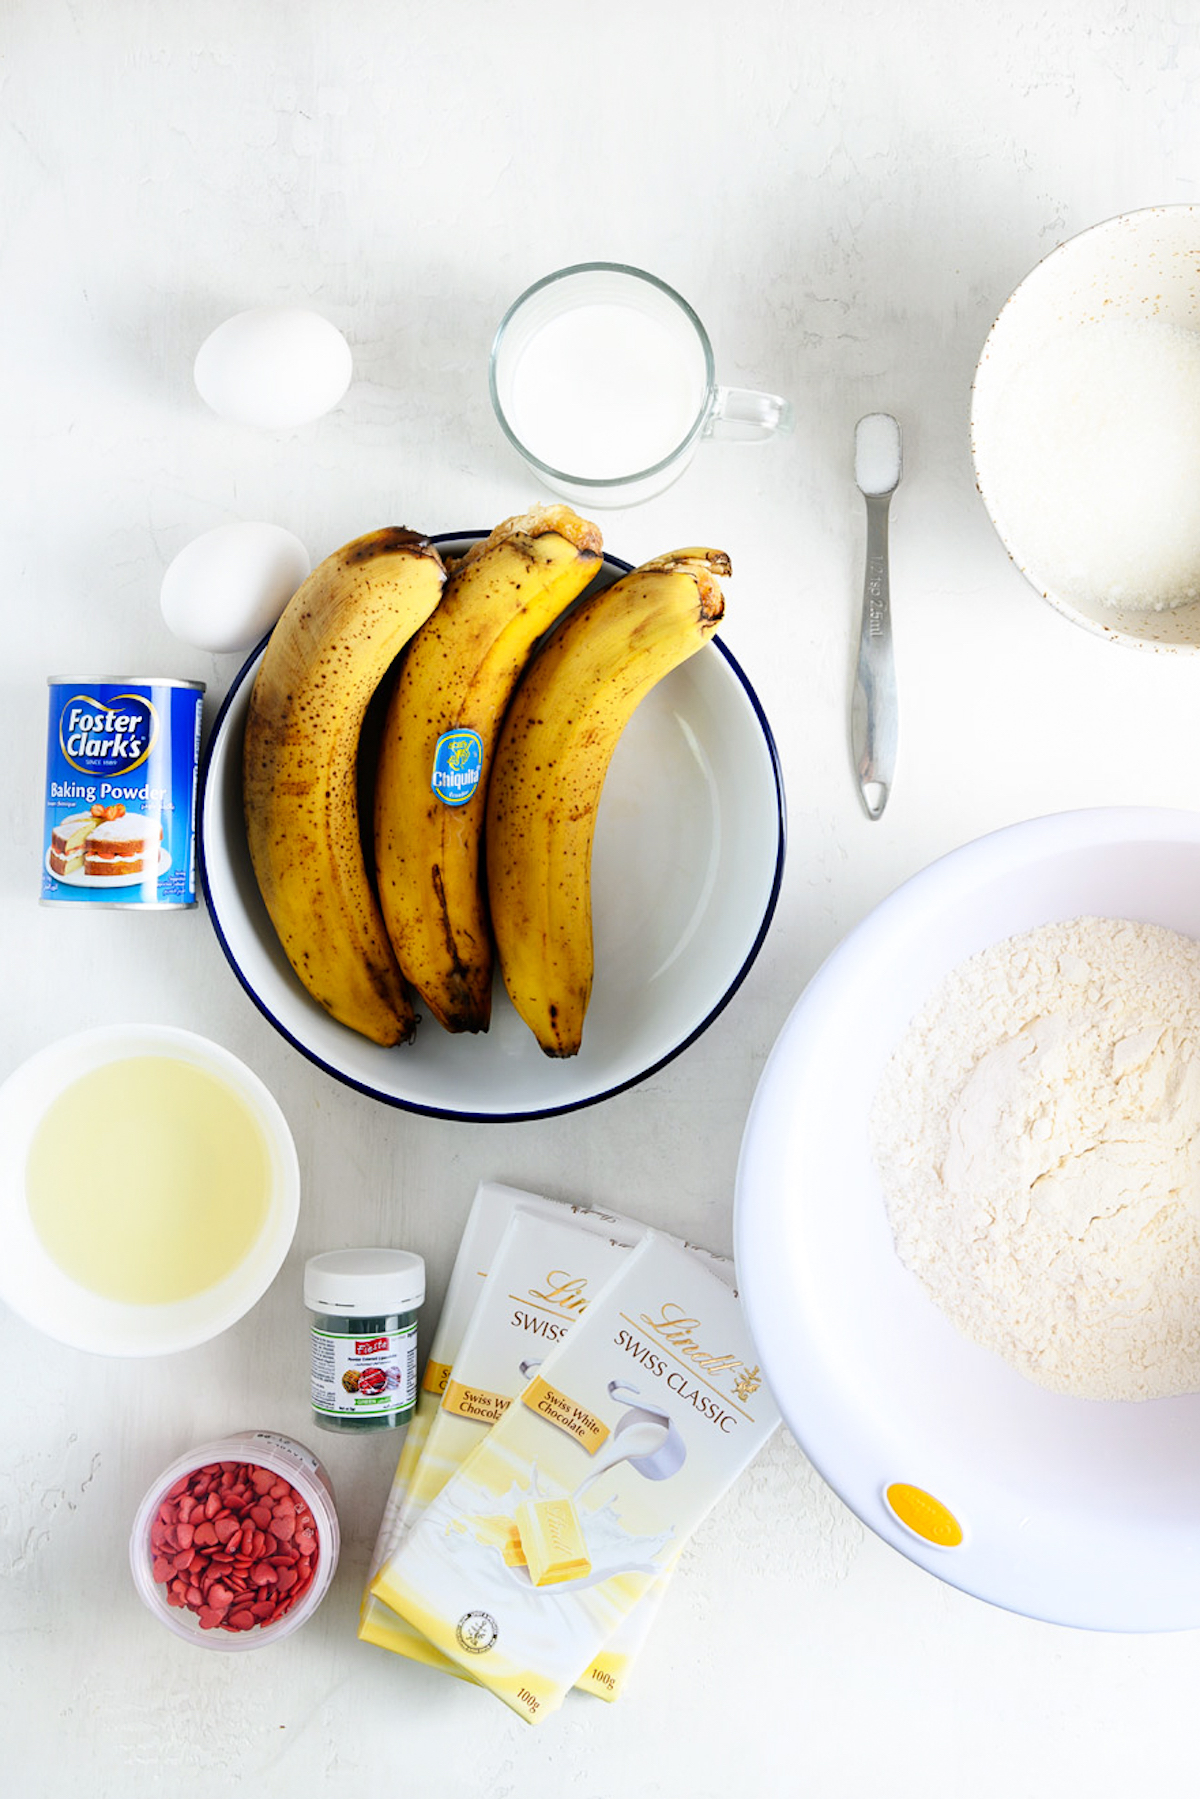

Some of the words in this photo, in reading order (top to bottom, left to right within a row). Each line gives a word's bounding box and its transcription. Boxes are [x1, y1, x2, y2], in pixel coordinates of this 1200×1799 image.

[866, 576, 882, 597] tsp
[869, 598, 884, 637] 2.5ml
[69, 708, 143, 734] Foster
[67, 733, 143, 759] Clark's
[51, 781, 97, 802] Baking
[100, 783, 167, 800] Powder
[432, 768, 479, 790] Chiquita
[640, 1303, 744, 1376] Lindt
[614, 1330, 668, 1377] SWISS
[667, 1372, 737, 1433] CLASSIC
[463, 1390, 492, 1406] Swiss
[537, 1400, 586, 1437] Chocolate
[544, 1391, 572, 1413] Swiss
[572, 1407, 600, 1435] White
[592, 1668, 616, 1690] 100g
[517, 1687, 541, 1714] 100g
